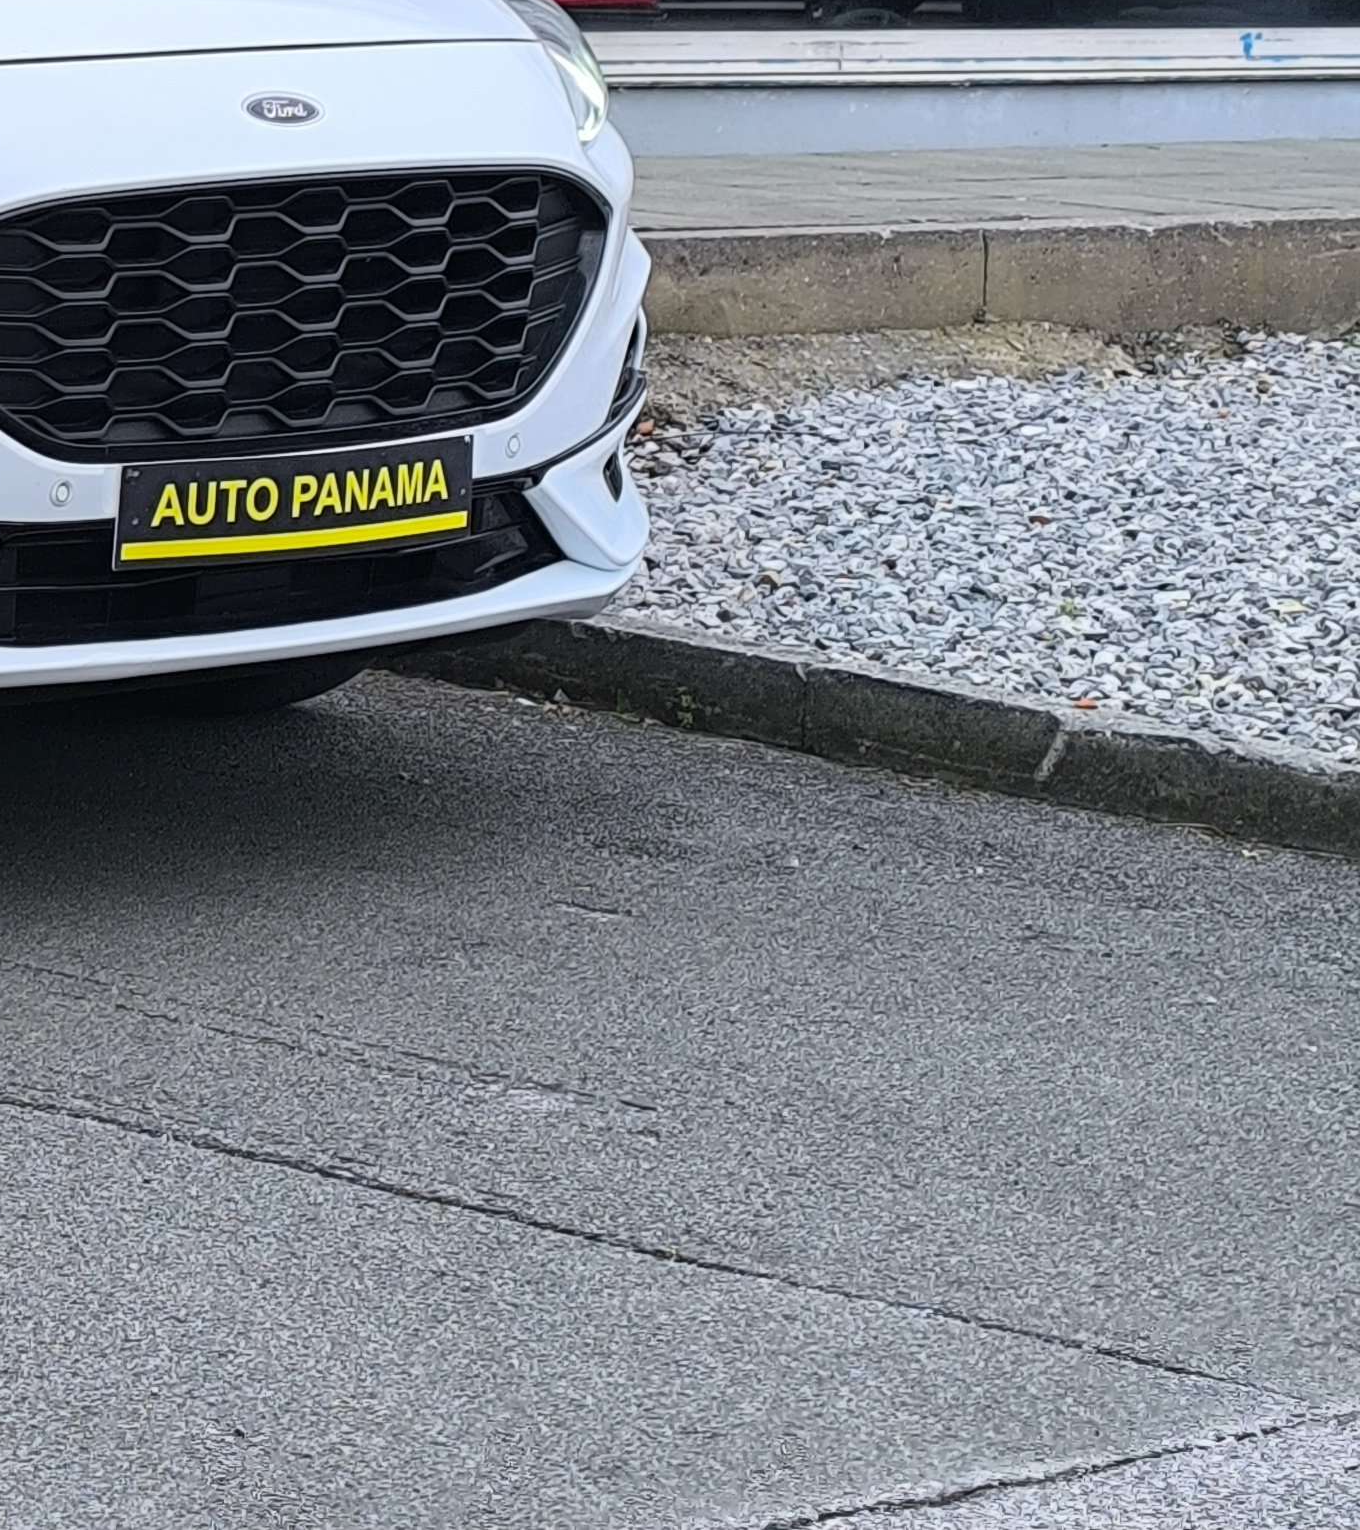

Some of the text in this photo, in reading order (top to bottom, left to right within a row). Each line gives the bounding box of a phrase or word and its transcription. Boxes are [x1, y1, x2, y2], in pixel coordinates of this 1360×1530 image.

[261, 98, 308, 118] Ford
[150, 459, 449, 527] AUTO PANAMA
